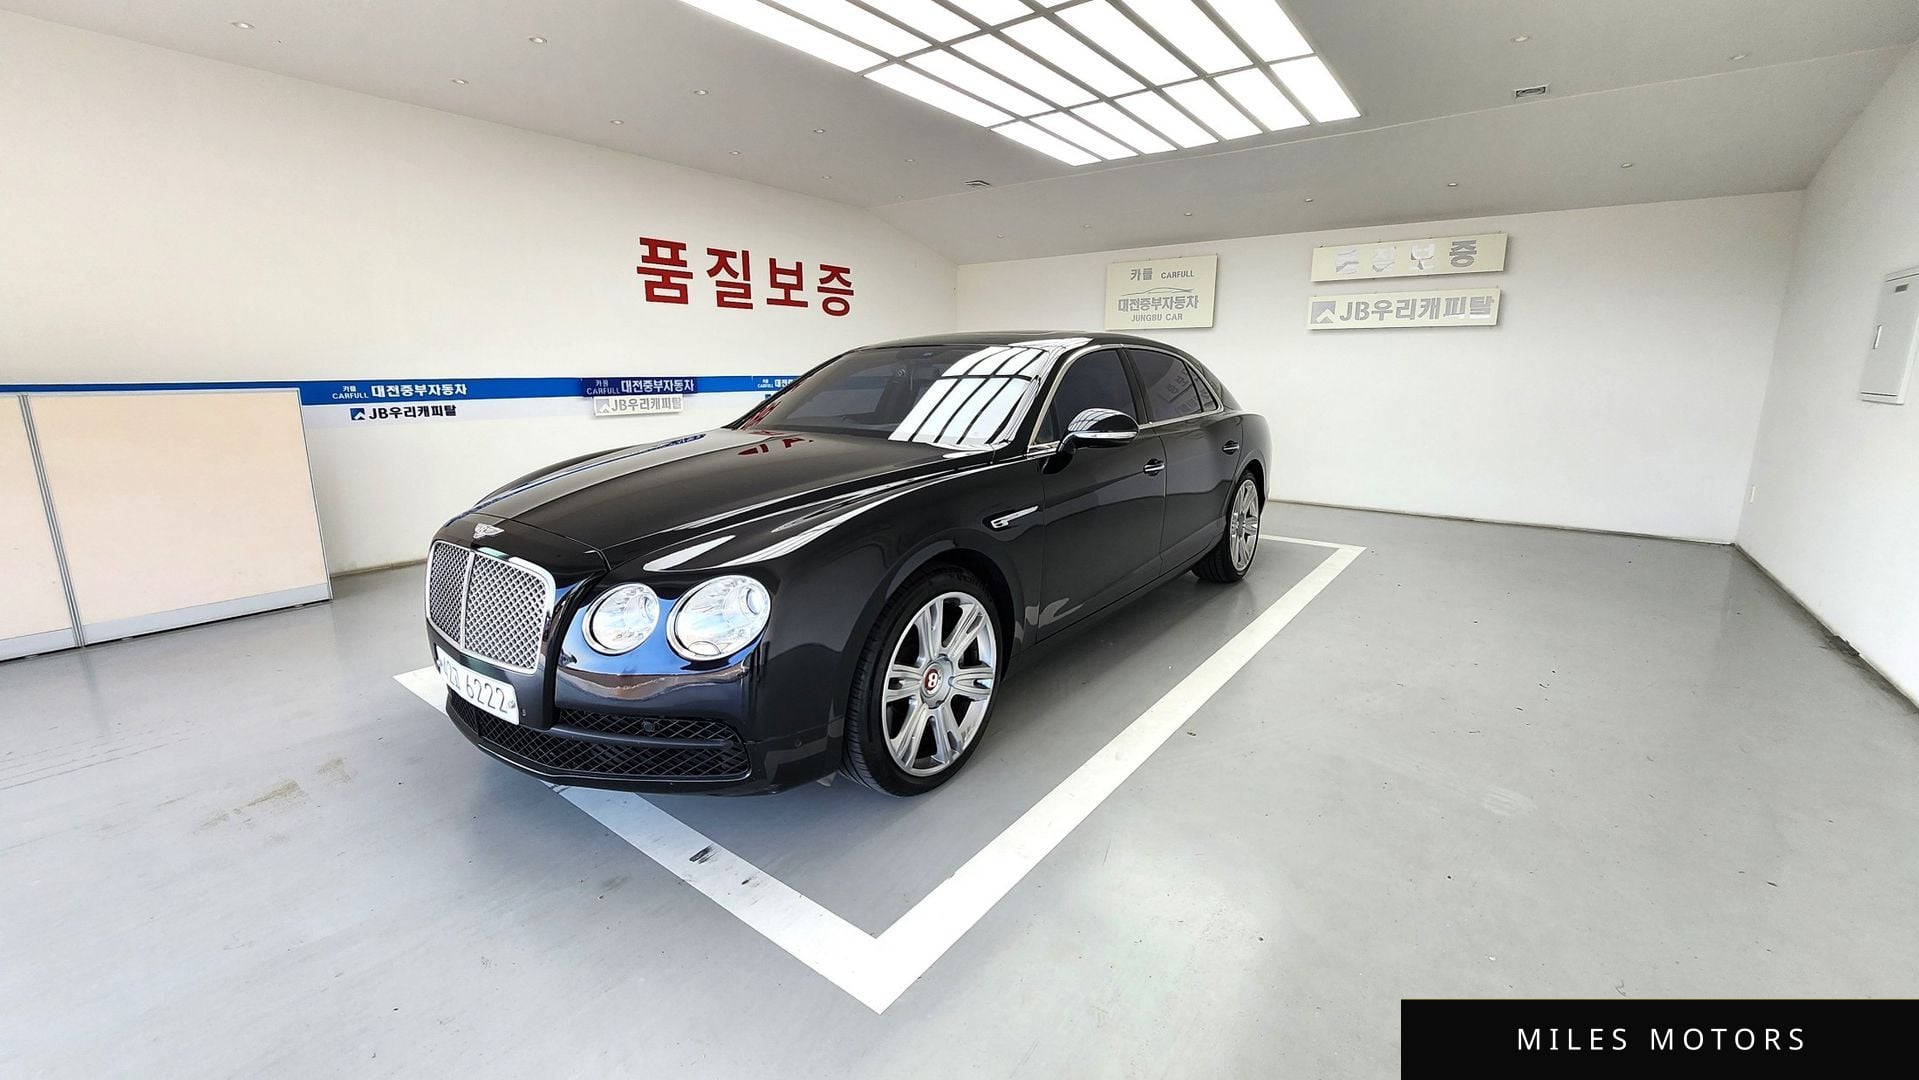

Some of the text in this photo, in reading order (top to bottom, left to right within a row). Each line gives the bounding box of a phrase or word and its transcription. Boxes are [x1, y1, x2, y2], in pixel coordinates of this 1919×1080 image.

[637, 237, 854, 316] 품질보증
[1161, 270, 1194, 279] CARFULL
[1131, 313, 1183, 322] JUNGBU CAR
[586, 387, 621, 395] CARFULL
[332, 392, 369, 400] CARFULL
[368, 405, 457, 420] JB우리캐피탈
[466, 674, 508, 714] 6222
